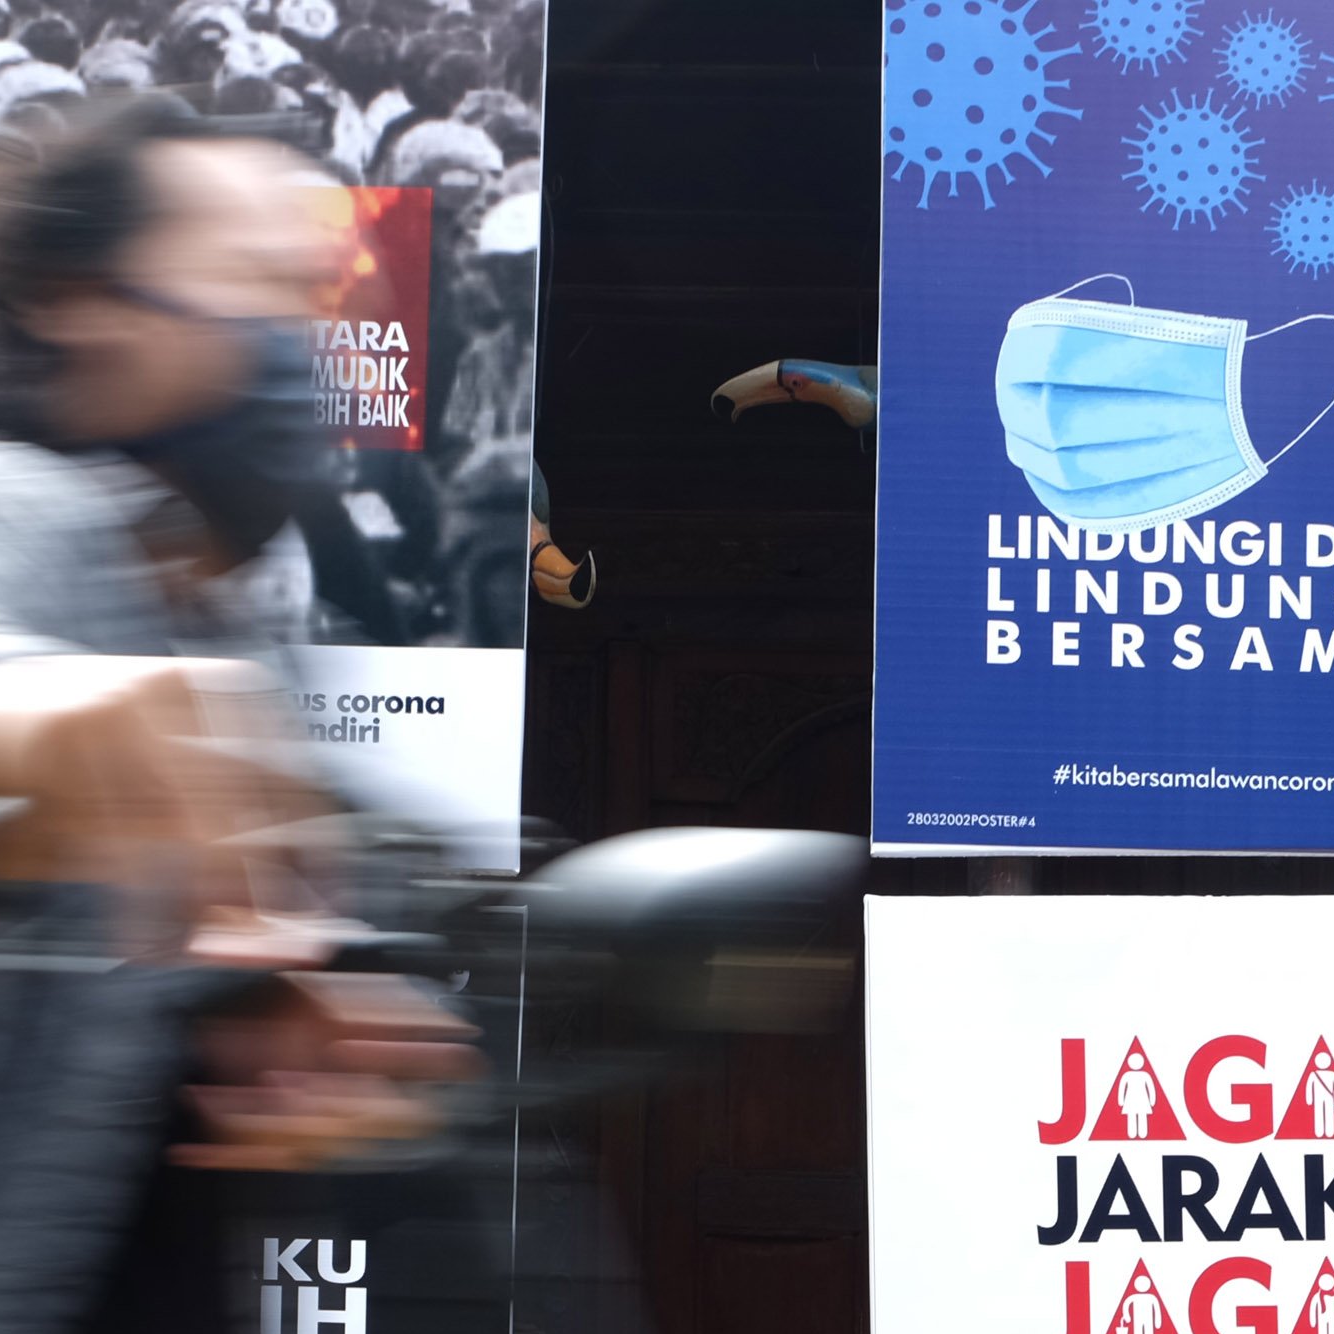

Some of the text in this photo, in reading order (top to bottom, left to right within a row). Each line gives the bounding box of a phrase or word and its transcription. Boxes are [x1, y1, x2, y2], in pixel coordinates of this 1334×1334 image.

[310, 355, 409, 392] MUDIK
[358, 394, 410, 428] BAIK
[987, 513, 1283, 567] LINDUNGI
[337, 694, 445, 715] corona
[906, 812, 1036, 829] 28032002POSTER#4
